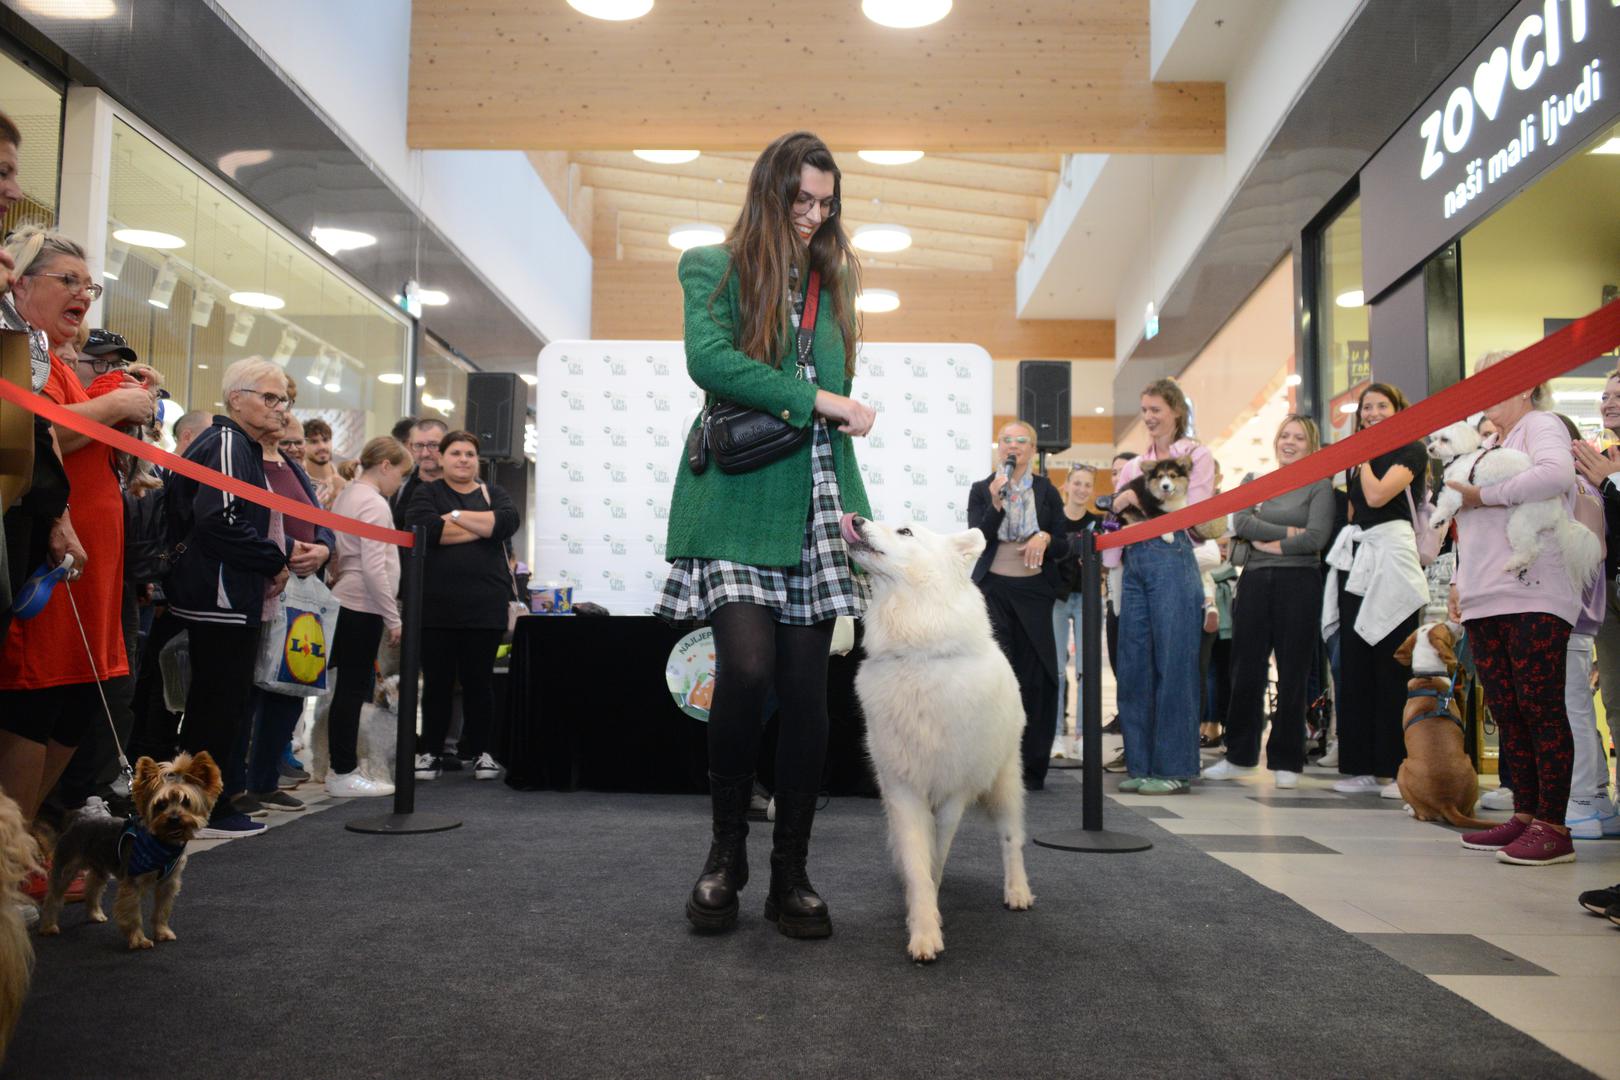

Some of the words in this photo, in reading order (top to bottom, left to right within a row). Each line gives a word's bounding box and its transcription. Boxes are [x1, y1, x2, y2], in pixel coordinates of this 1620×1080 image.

[1443, 158, 1484, 219] naši
[1488, 114, 1537, 184] mali
[1541, 58, 1601, 146] ljudi
